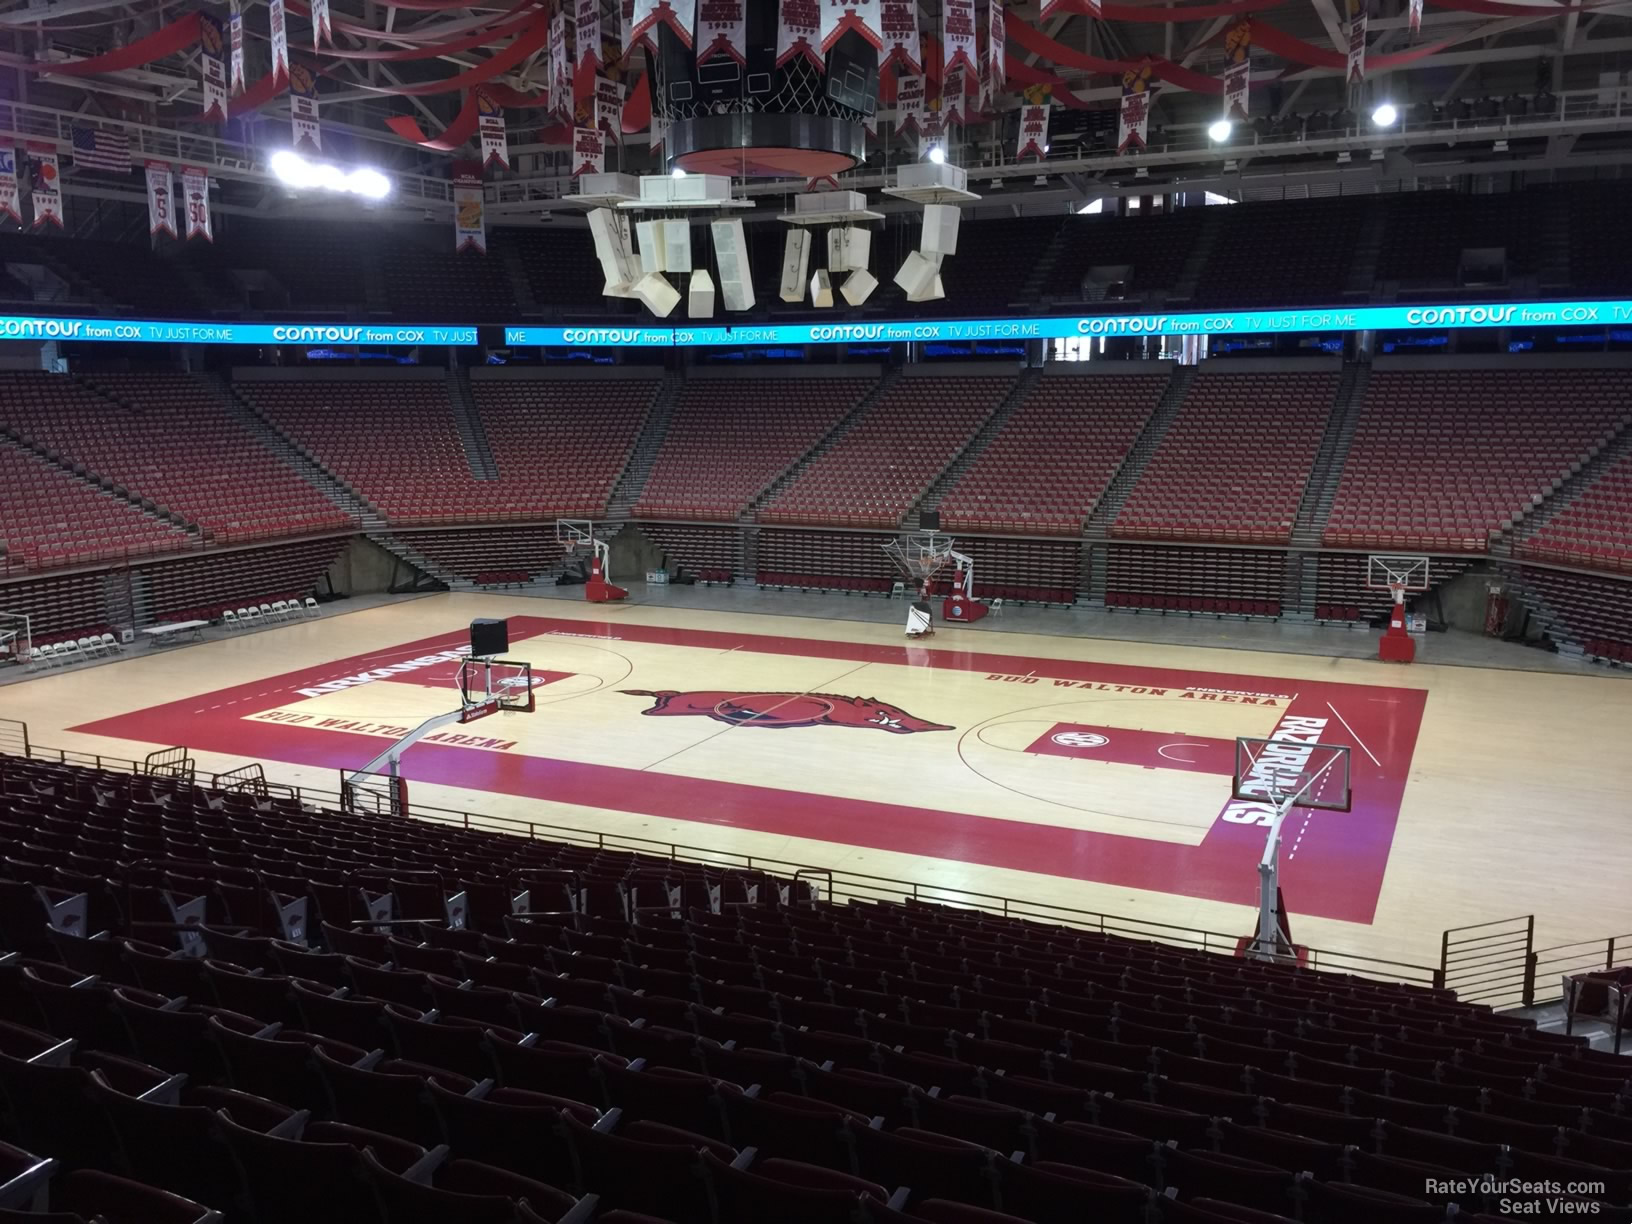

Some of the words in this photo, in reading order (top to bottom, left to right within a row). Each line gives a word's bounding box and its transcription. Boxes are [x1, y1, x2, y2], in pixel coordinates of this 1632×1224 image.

[157, 199, 167, 219] 5
[190, 202, 207, 224] 50
[1521, 308, 1557, 322] from
[1561, 307, 1599, 321] COX
[1613, 306, 1632, 320] TV
[1170, 319, 1200, 331] from
[1203, 318, 1234, 330] COX
[1246, 316, 1262, 328] TV
[1266, 315, 1298, 328] JUST
[1302, 314, 1331, 328] FOR
[1335, 314, 1356, 327] ME
[86, 325, 112, 337] from
[114, 326, 142, 338] COX
[150, 327, 162, 338] TV
[165, 327, 190, 339] JUST
[193, 328, 214, 339] FOR
[217, 328, 233, 340] ME
[366, 330, 393, 342] from
[396, 331, 424, 342] COX
[433, 331, 448, 342] TV
[451, 331, 478, 342] JUST
[508, 331, 526, 342] ME
[702, 331, 713, 341] TV
[715, 331, 737, 341] JUST
[740, 330, 761, 341] FOR
[763, 330, 778, 341] ME
[887, 327, 912, 338] from
[914, 326, 940, 337] COX
[948, 326, 962, 337] TV
[965, 325, 991, 337] JUST
[995, 324, 1018, 336] FOR
[1022, 323, 1040, 335] ME
[644, 332, 668, 342] from
[671, 332, 694, 342] COX
[985, 674, 1039, 685] BUD
[1053, 679, 1168, 696] WALTON
[1178, 691, 1278, 706] ARENA
[1185, 686, 1290, 699] #NEVERYIELD
[256, 710, 309, 723] BUD
[424, 732, 519, 751] ARENA
